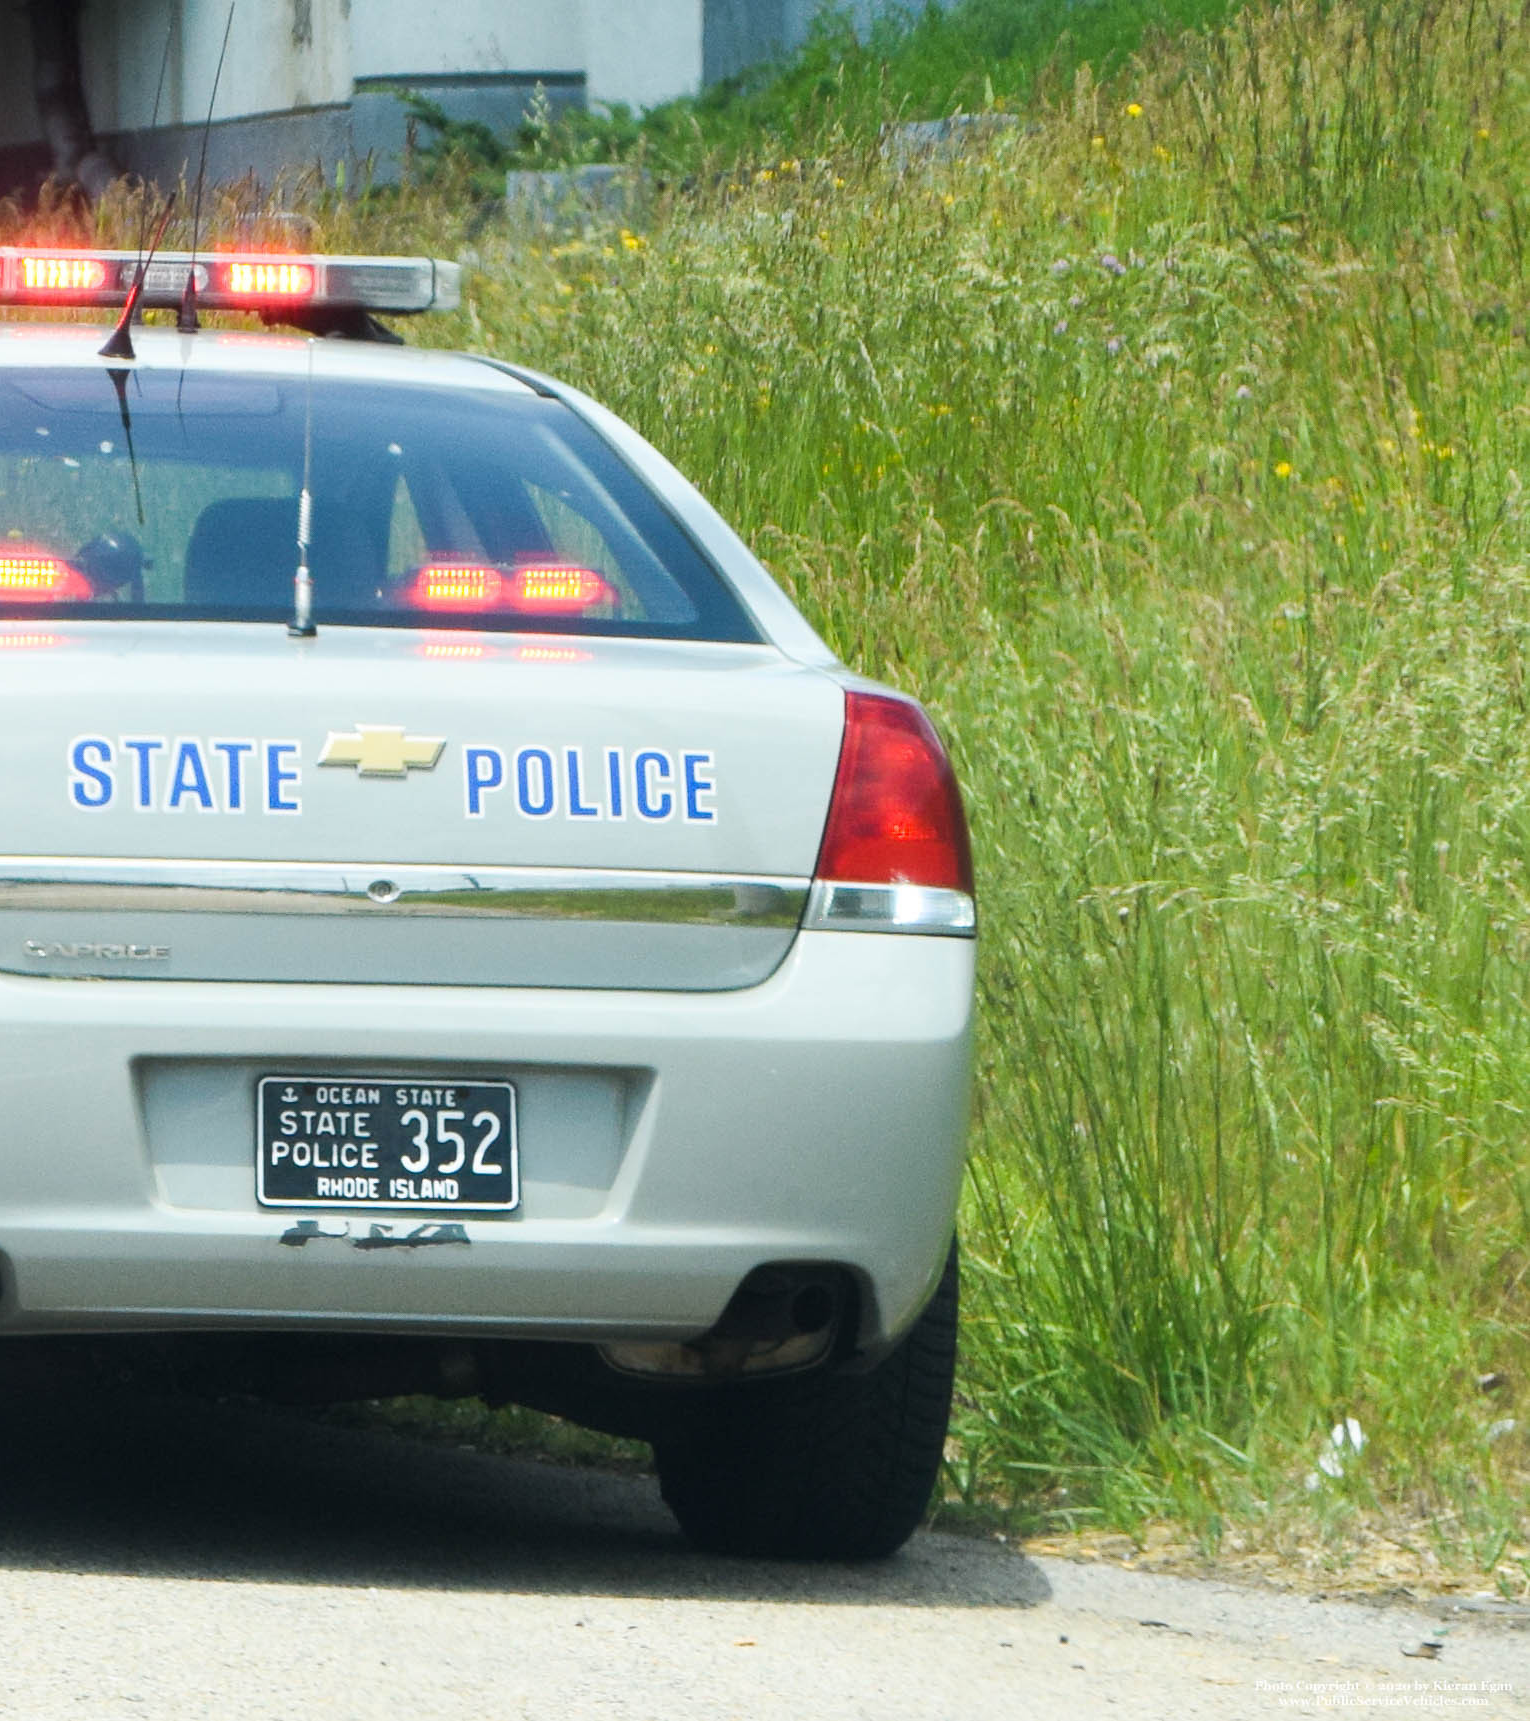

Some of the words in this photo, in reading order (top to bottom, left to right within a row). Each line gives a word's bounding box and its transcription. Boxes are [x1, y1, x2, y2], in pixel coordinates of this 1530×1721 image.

[69, 736, 301, 813] STATE
[462, 745, 718, 824] POLICE
[23, 940, 171, 960] CAPRICE
[316, 1087, 380, 1105] OCEAN
[396, 1089, 456, 1107] STATE
[280, 1111, 371, 1137] STATE
[271, 1141, 379, 1168] POLICE
[400, 1110, 502, 1175] 352
[317, 1177, 380, 1198] RHODE
[389, 1178, 459, 1200] ISLAND
